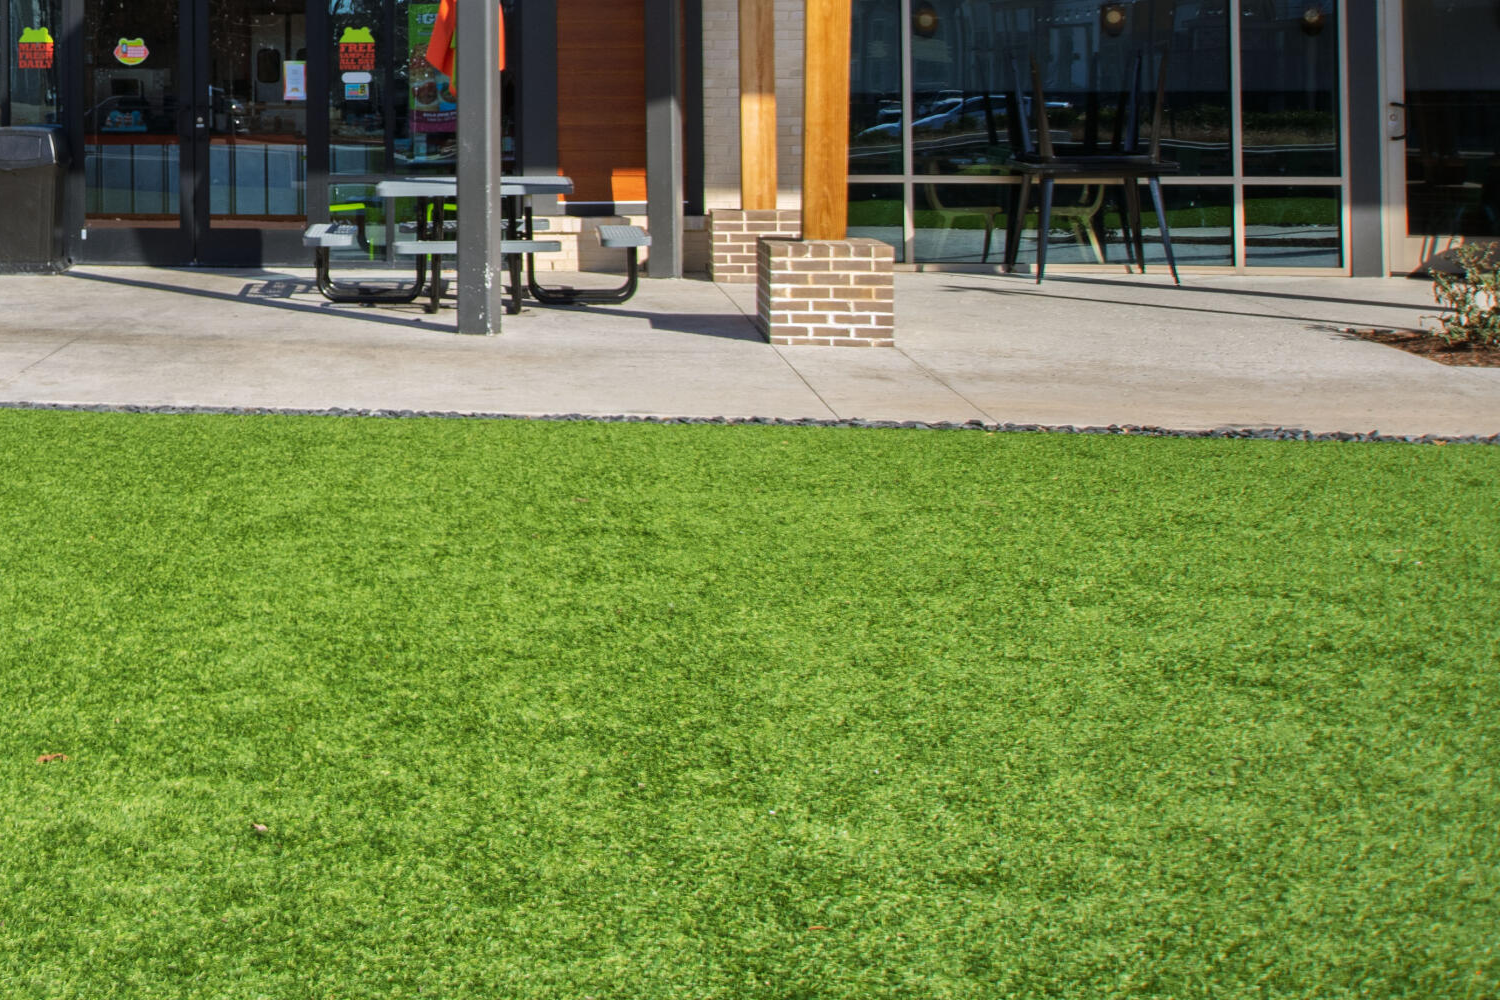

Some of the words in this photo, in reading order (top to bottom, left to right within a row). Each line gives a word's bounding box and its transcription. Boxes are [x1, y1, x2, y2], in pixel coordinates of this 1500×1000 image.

[19, 43, 54, 51] MADE
[339, 43, 375, 52] FREE
[19, 51, 54, 60] FRESH
[19, 60, 53, 69] DAILY
